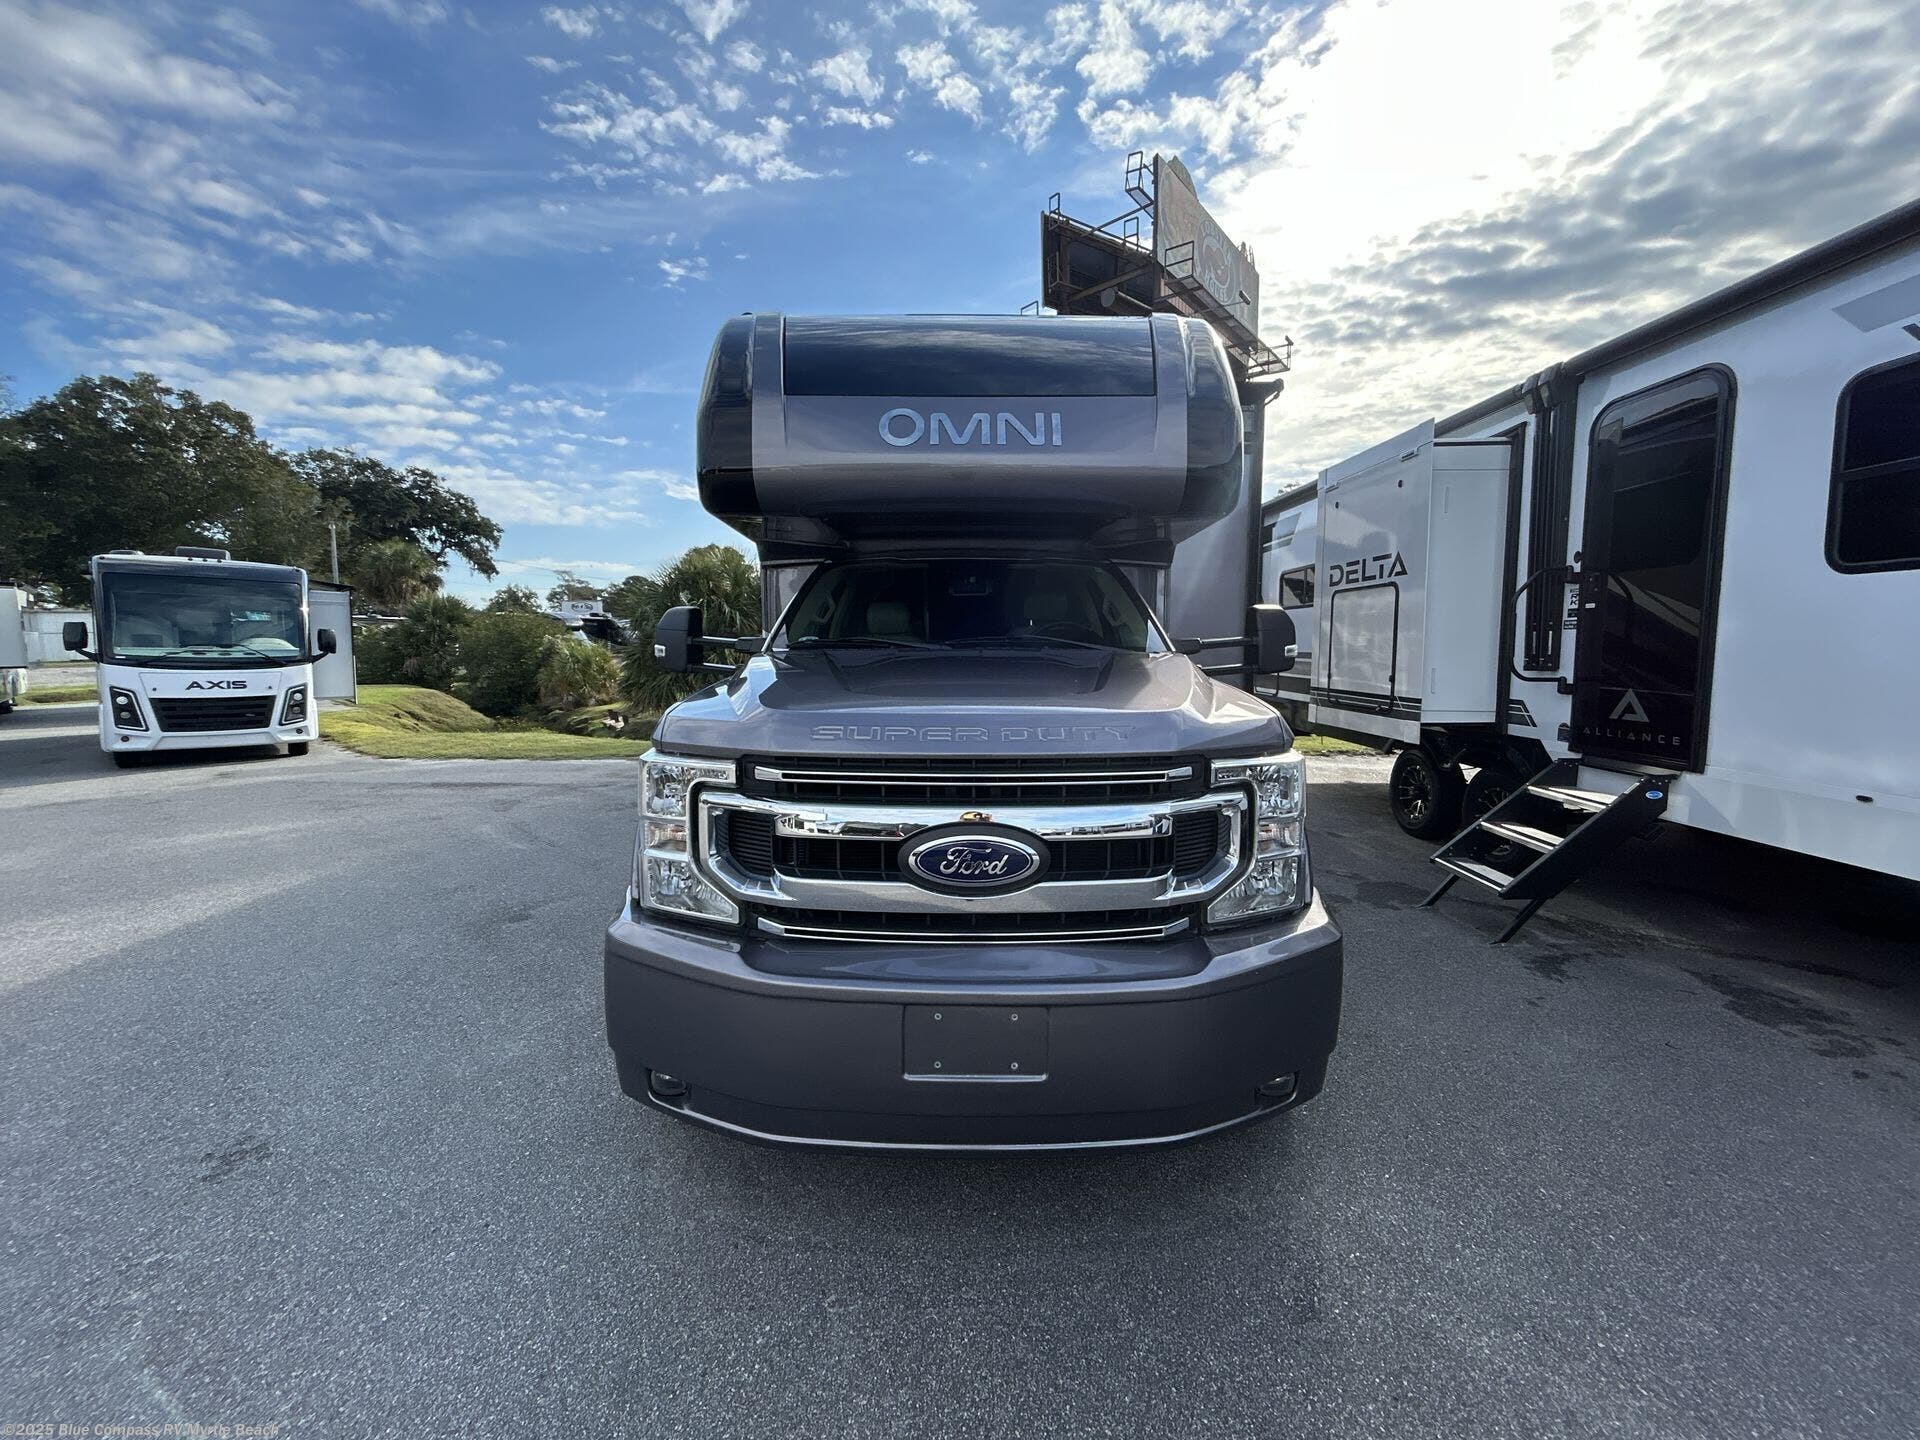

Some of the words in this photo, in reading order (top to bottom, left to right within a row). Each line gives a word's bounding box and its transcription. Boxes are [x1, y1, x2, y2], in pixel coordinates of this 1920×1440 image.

[878, 408, 1062, 447] OMNI
[1329, 551, 1408, 587] DELTA
[185, 680, 248, 690] AXIS
[812, 726, 991, 742] SUPER
[1000, 726, 1136, 742] DUTY
[1583, 727, 1681, 746] ALLIANCE
[940, 846, 1009, 875] Ford
